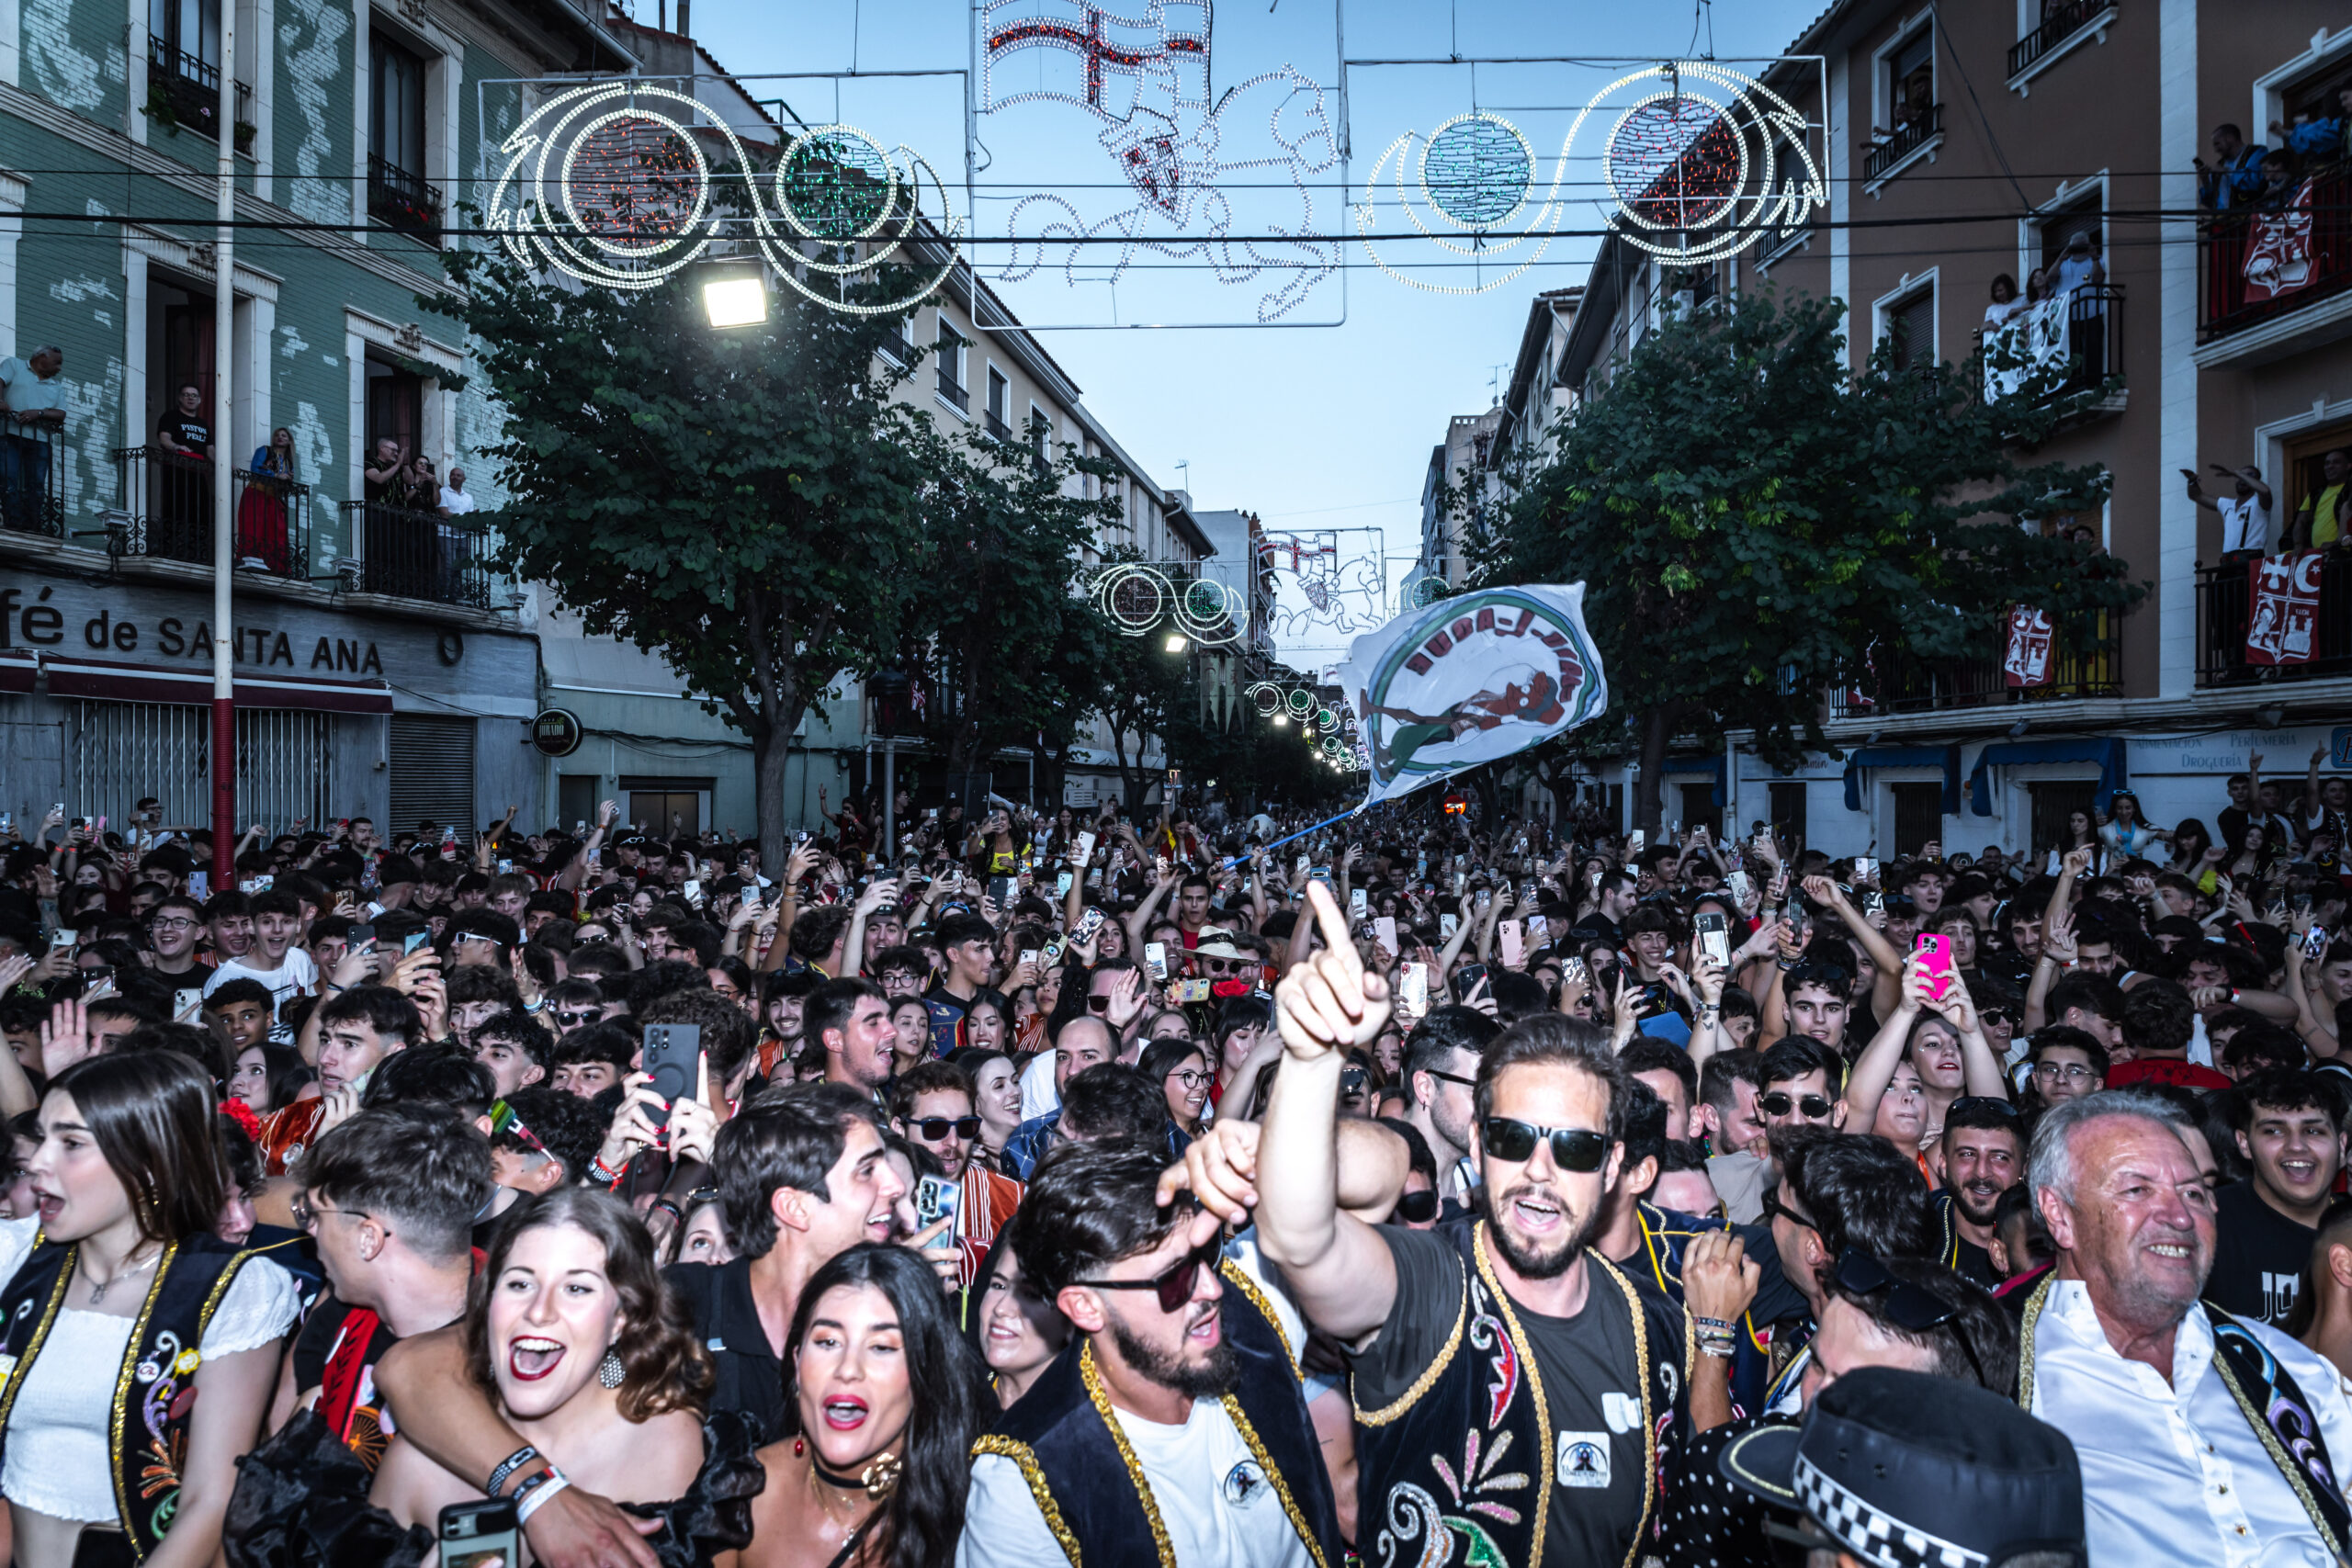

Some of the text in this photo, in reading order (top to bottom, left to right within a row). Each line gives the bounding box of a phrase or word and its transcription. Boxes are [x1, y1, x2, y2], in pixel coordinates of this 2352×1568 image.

[85, 609, 139, 652] de
[157, 616, 295, 667] SANTA
[311, 636, 384, 675] ANA
